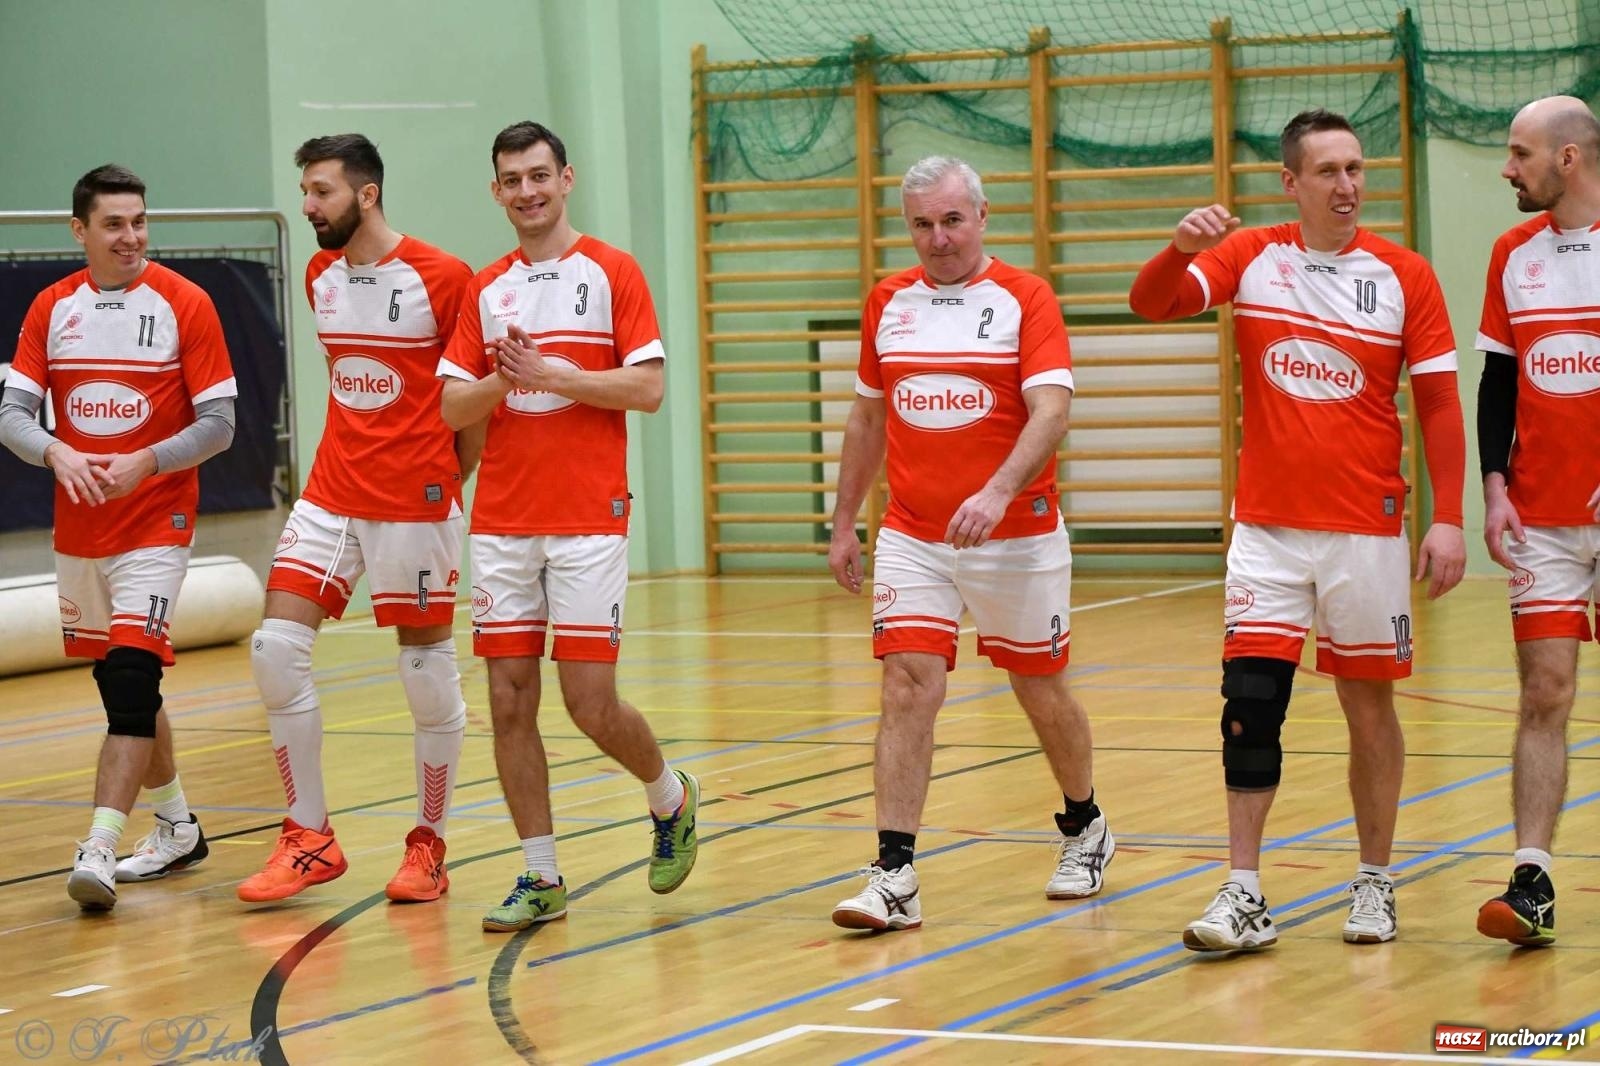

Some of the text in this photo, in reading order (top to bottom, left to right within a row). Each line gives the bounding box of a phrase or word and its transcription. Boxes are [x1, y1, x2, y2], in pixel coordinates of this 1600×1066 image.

[388, 289, 403, 322] 6
[575, 283, 589, 316] 3
[1354, 279, 1377, 314] 10
[138, 314, 155, 347] 11
[977, 307, 993, 338] 2
[1270, 351, 1357, 390] Henkel
[1531, 351, 1600, 376] Henke
[333, 369, 394, 394] Henkel
[70, 396, 143, 419] Henkel
[897, 389, 985, 411] Henkel
[418, 570, 431, 611] 6
[143, 594, 169, 640] 11
[609, 602, 620, 648] 3
[1051, 614, 1062, 658] 2
[1391, 614, 1412, 664] 10
